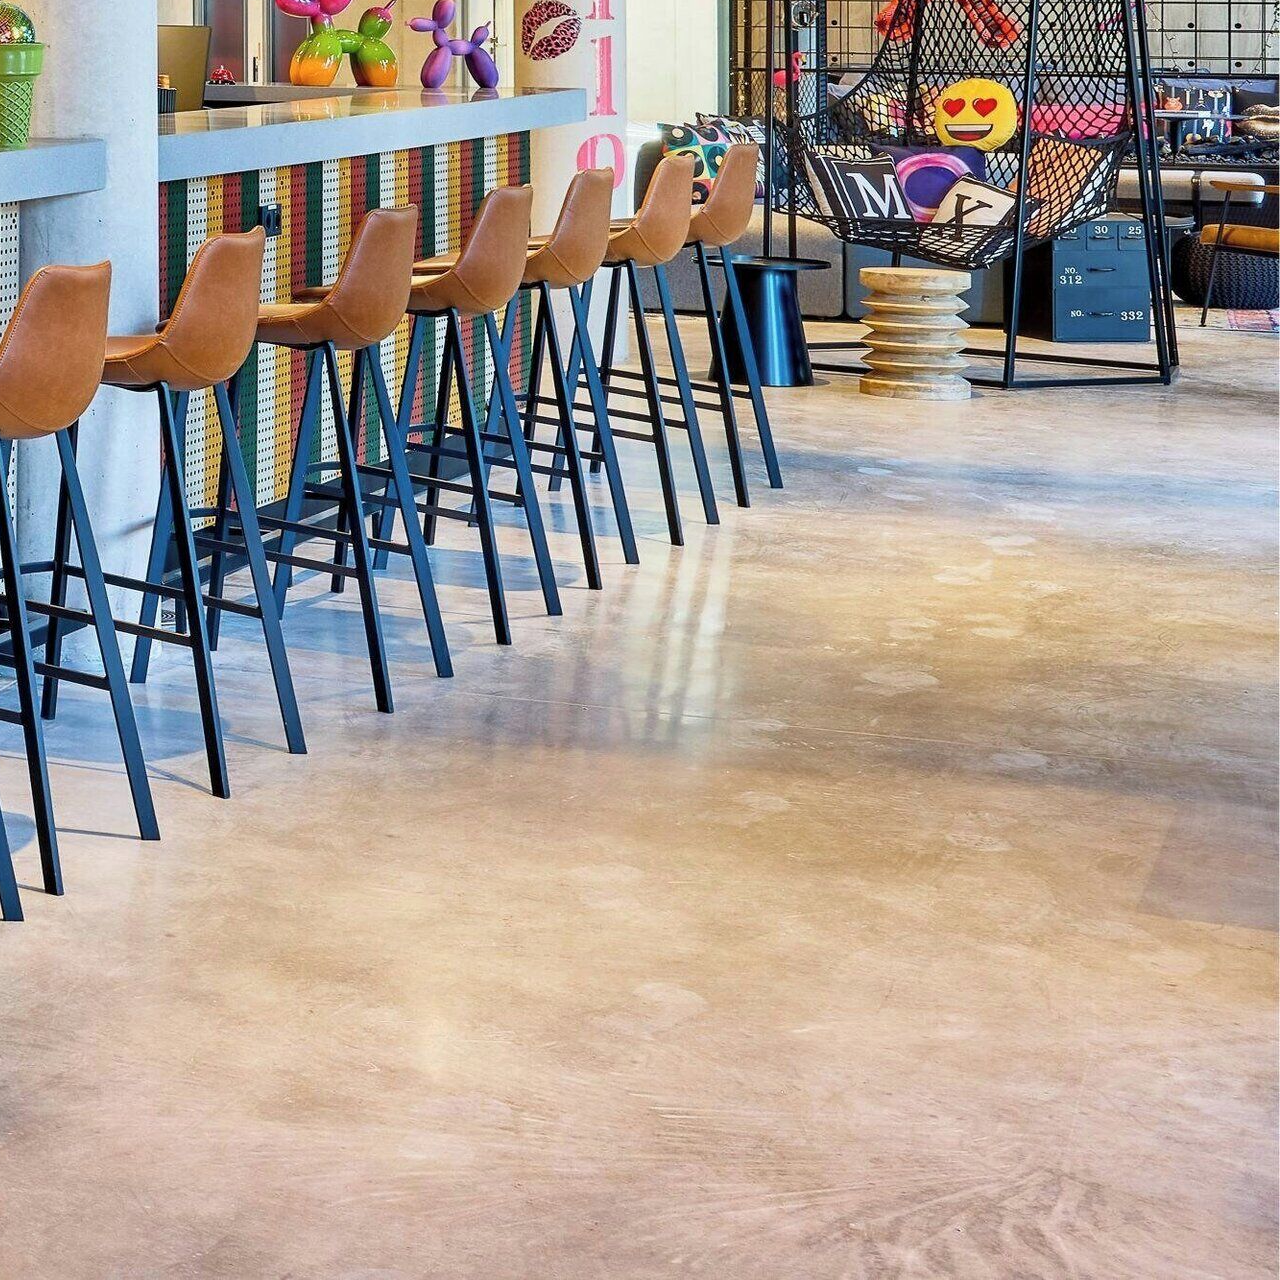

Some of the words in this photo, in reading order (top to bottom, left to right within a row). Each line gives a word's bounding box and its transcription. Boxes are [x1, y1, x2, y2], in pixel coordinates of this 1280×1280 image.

[846, 173, 912, 220] M
[1095, 225, 1108, 234] 30
[1128, 226, 1142, 235] 25
[1060, 275, 1083, 285] 312
[1121, 311, 1144, 321] 332
